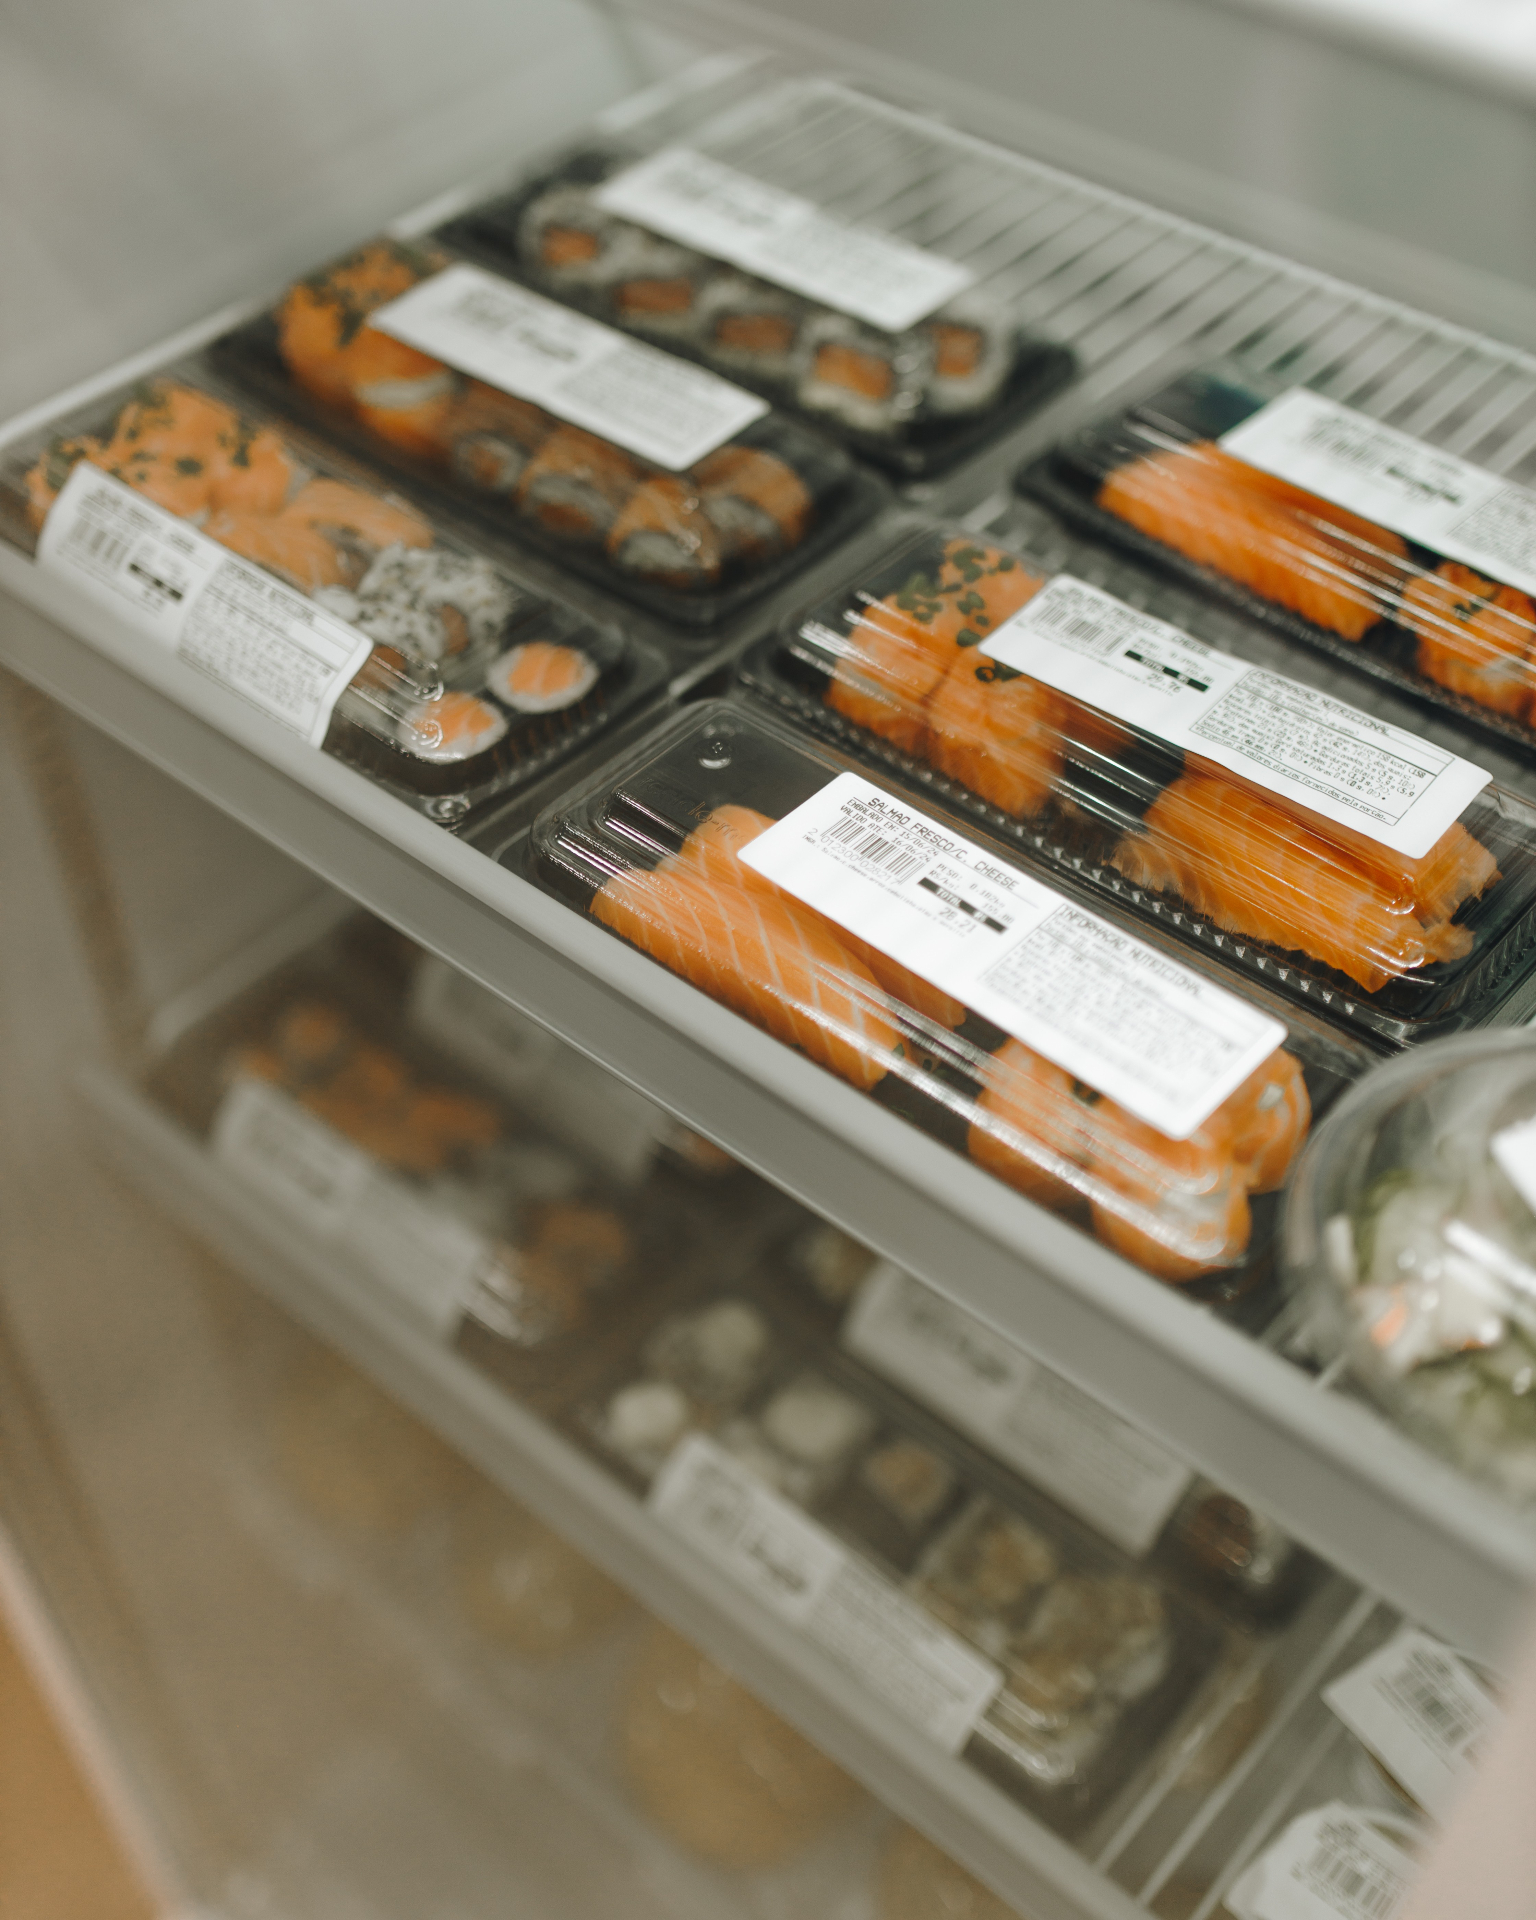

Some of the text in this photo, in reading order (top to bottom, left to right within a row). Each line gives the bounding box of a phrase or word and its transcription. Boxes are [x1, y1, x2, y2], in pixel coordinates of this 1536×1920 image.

[1144, 671, 1185, 694] 29.76
[805, 826, 820, 837] 2
[817, 834, 861, 863] 012300
[836, 803, 934, 864] VALIDO ATE: 16/06/24
[844, 797, 886, 824] EMBALADO
[896, 829, 942, 858] 15/06/24
[865, 796, 1021, 892] SALMAO FRESCO/C. CHEESE
[933, 886, 965, 907] TOTAL
[936, 905, 979, 934] 28.21
